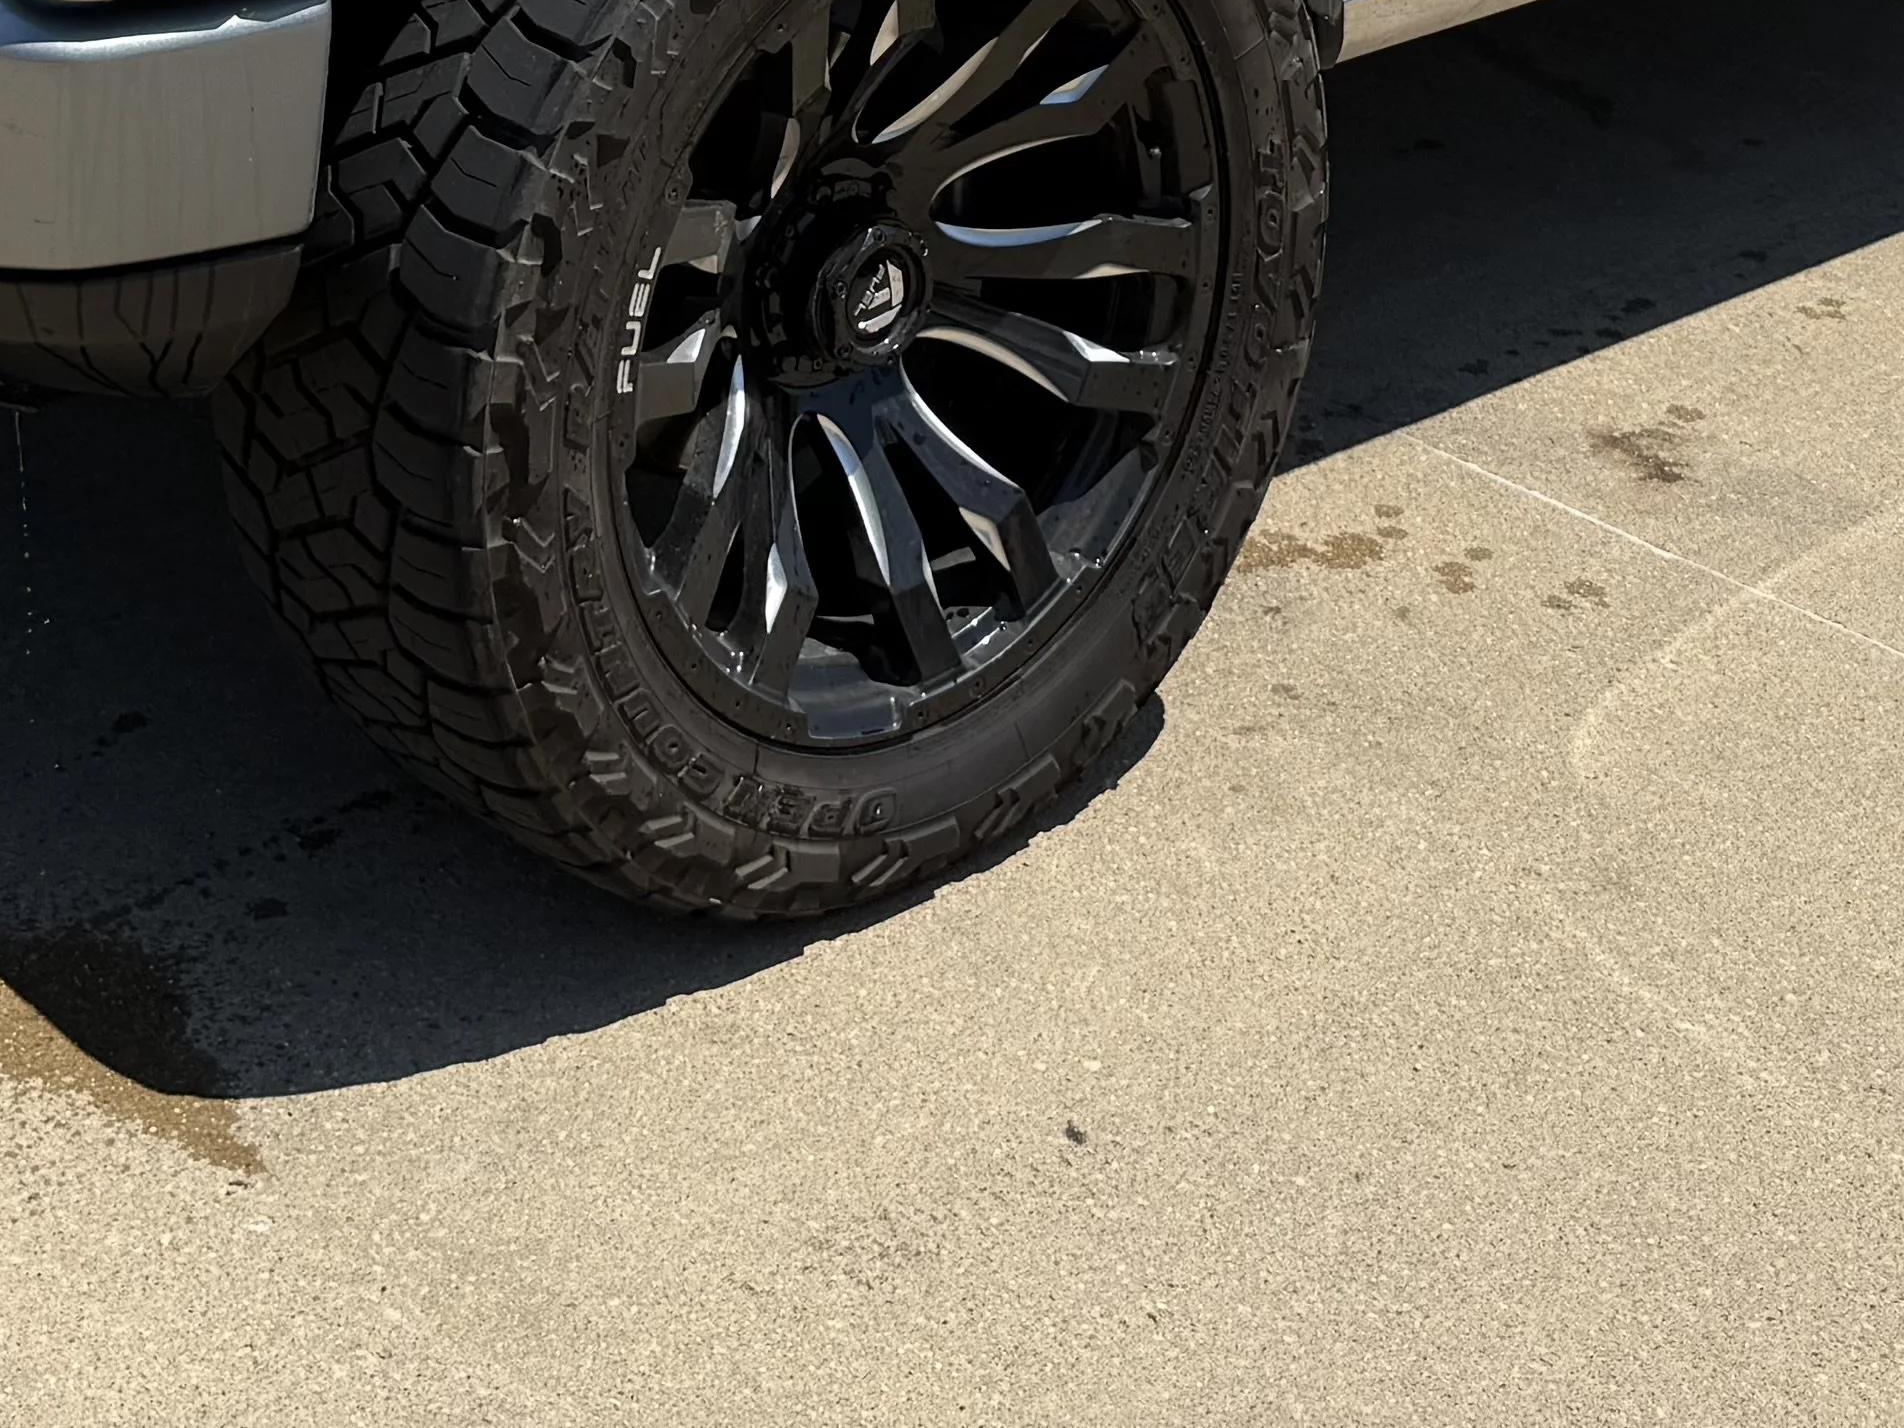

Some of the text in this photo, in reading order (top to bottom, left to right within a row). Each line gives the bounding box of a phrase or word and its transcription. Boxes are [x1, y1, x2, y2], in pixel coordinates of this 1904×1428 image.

[616, 246, 662, 394] FUEL
[1241, 137, 1286, 370] TOYO
[725, 773, 897, 838] OPEN
